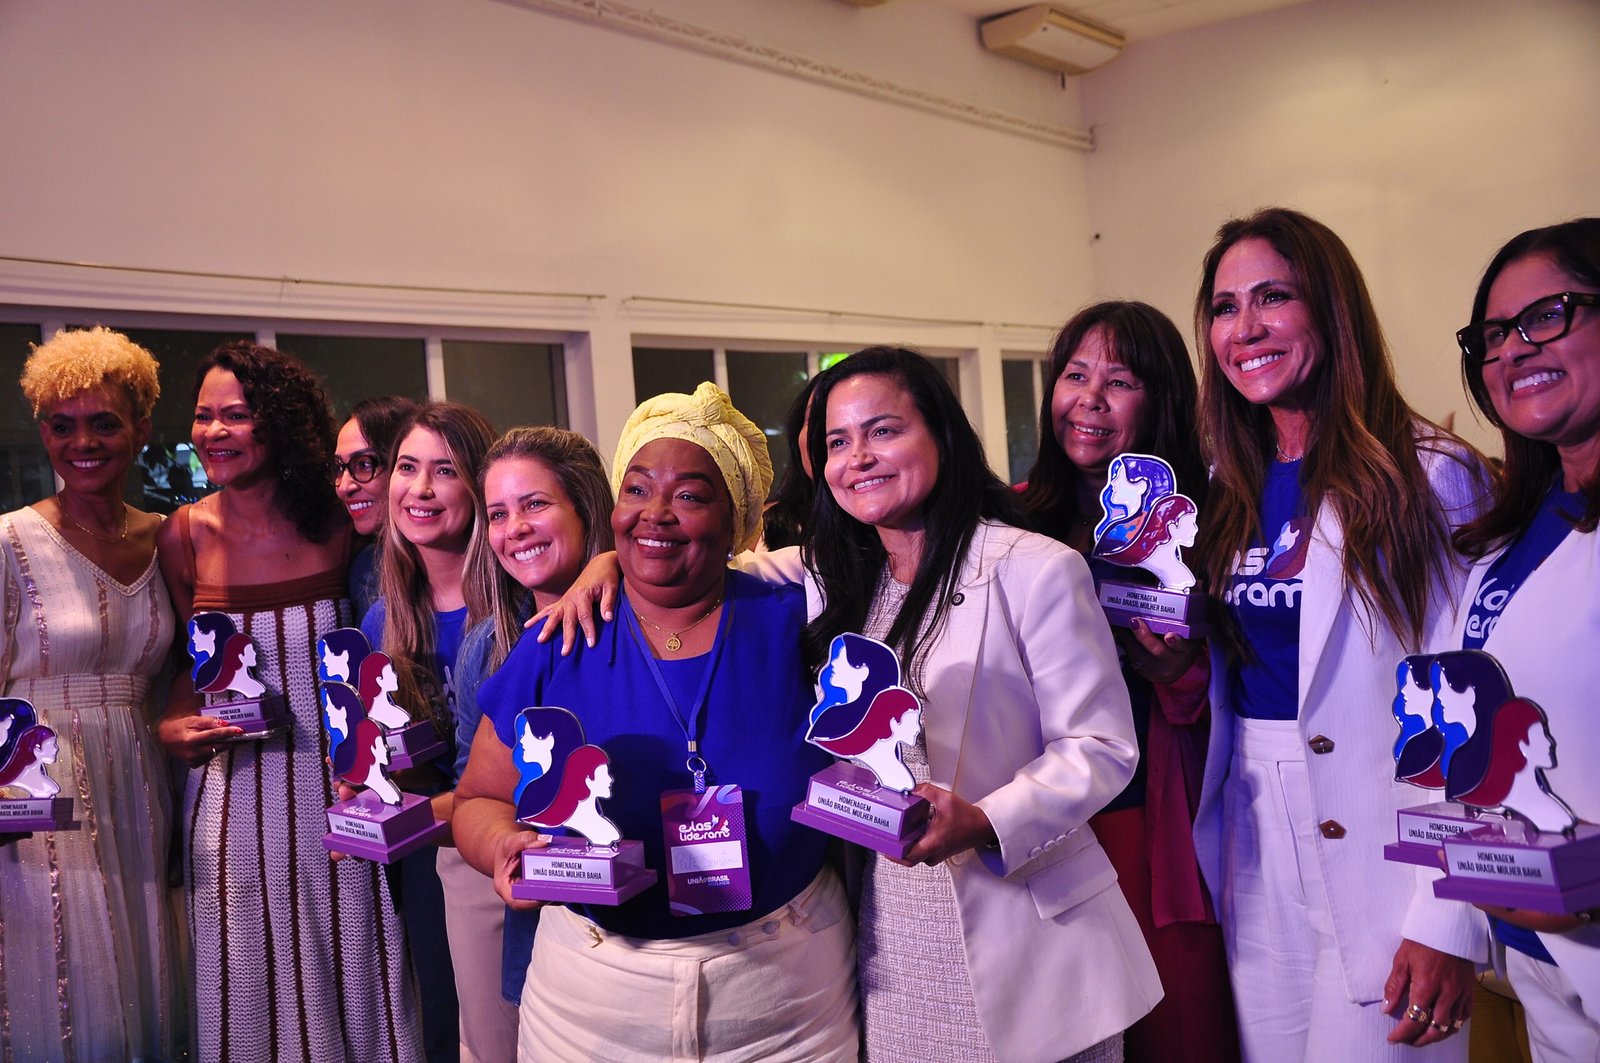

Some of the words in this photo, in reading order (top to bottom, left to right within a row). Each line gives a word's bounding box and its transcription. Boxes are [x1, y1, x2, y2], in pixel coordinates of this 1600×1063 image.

[1126, 591, 1158, 603] HOMENAGEM
[1122, 598, 1139, 608] BRASIL
[1140, 601, 1160, 611] MULHER
[1161, 604, 1176, 614] BAHIA
[838, 795, 872, 812] HOMENAGEM
[818, 796, 833, 808] UNIÃO
[834, 802, 851, 814] BRASIL
[852, 809, 873, 822] MULHER
[874, 816, 890, 827] BAHIA
[679, 821, 712, 833] elas
[1428, 822, 1464, 834] HOMENAGEM
[1408, 829, 1425, 839] UNIÃO
[1477, 852, 1515, 864] HOMENAGEM
[551, 861, 582, 870] HOMENAGEM
[1457, 861, 1475, 872] UNIÃO
[1475, 863, 1496, 874] BRASIL
[1496, 865, 1523, 877] MULHER
[1522, 867, 1543, 878] BAHIA
[532, 867, 548, 876] UNIÃO
[548, 869, 565, 878] BRASIL
[566, 870, 586, 879] MULHER
[586, 872, 602, 880] BAHIA
